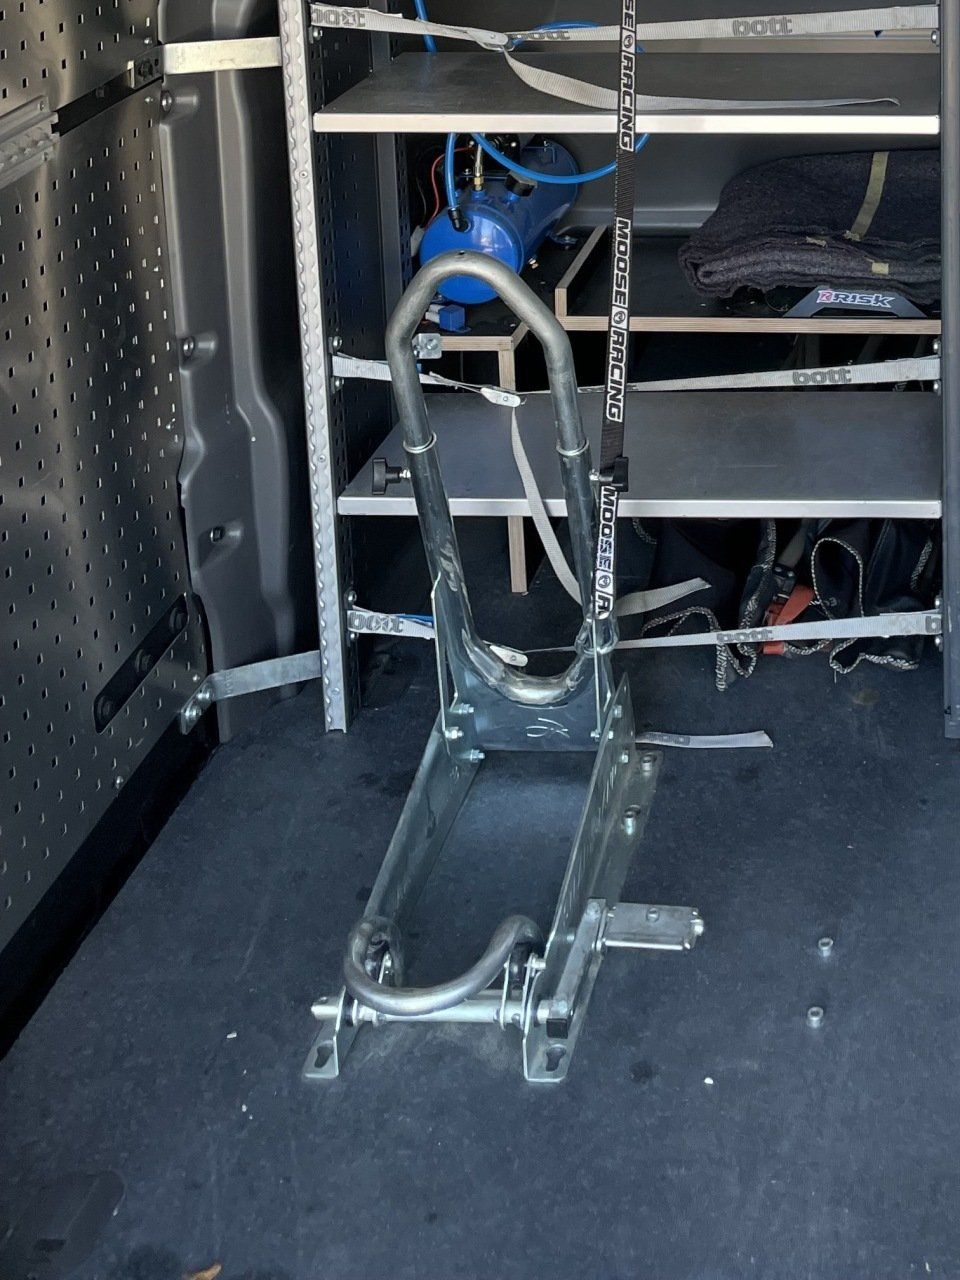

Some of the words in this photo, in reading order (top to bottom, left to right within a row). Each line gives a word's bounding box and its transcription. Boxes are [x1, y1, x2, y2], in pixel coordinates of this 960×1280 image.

[733, 16, 793, 37] bott
[619, 51, 636, 153] RACING
[612, 216, 631, 307] MOOSE
[606, 327, 628, 423] RACING
[792, 367, 852, 385] bott
[597, 486, 618, 573] MOOSE
